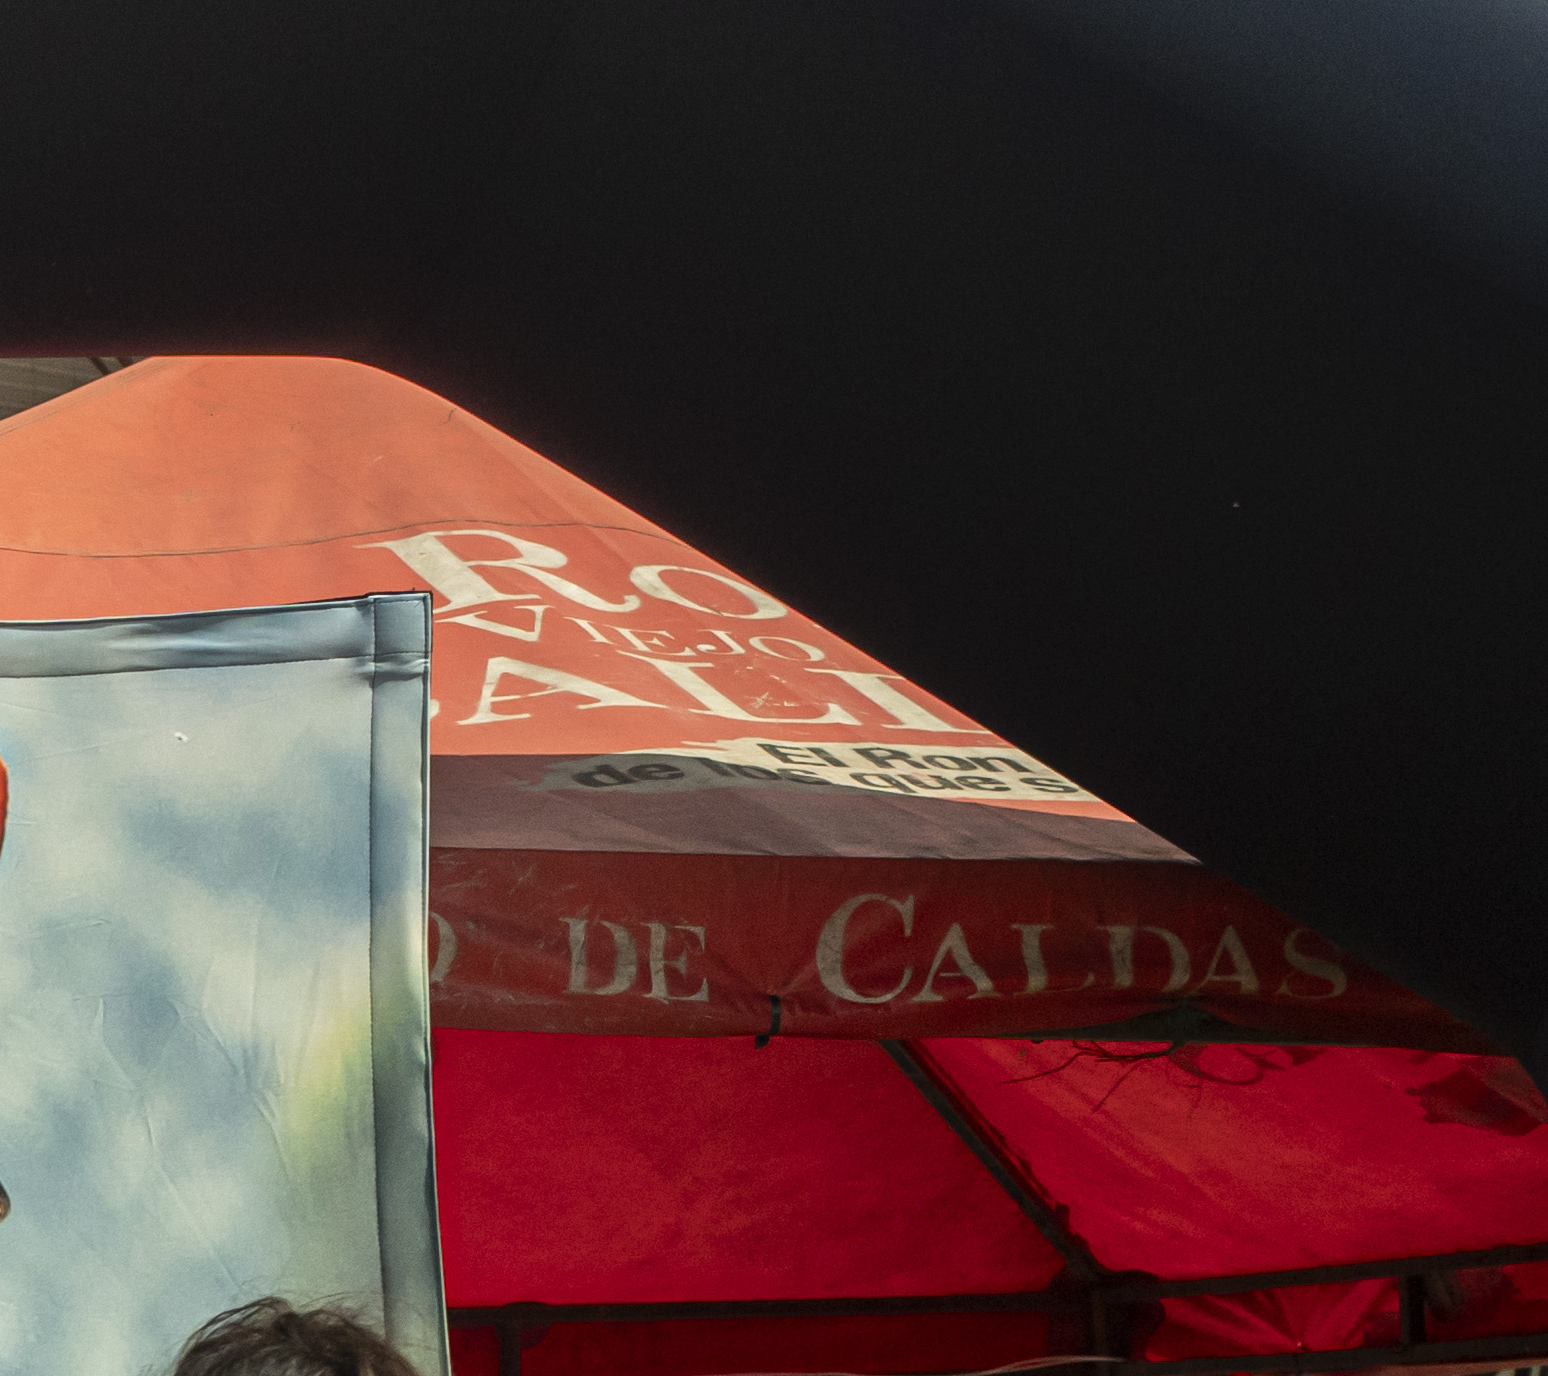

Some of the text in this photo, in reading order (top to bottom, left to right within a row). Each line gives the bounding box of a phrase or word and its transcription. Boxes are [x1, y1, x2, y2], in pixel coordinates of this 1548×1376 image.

[436, 606, 826, 662] VIEJO
[572, 758, 685, 790] de
[856, 771, 1017, 795] que
[756, 741, 1034, 775] El Ron
[558, 915, 710, 1002] DE
[814, 892, 1349, 1005] CALDAS
